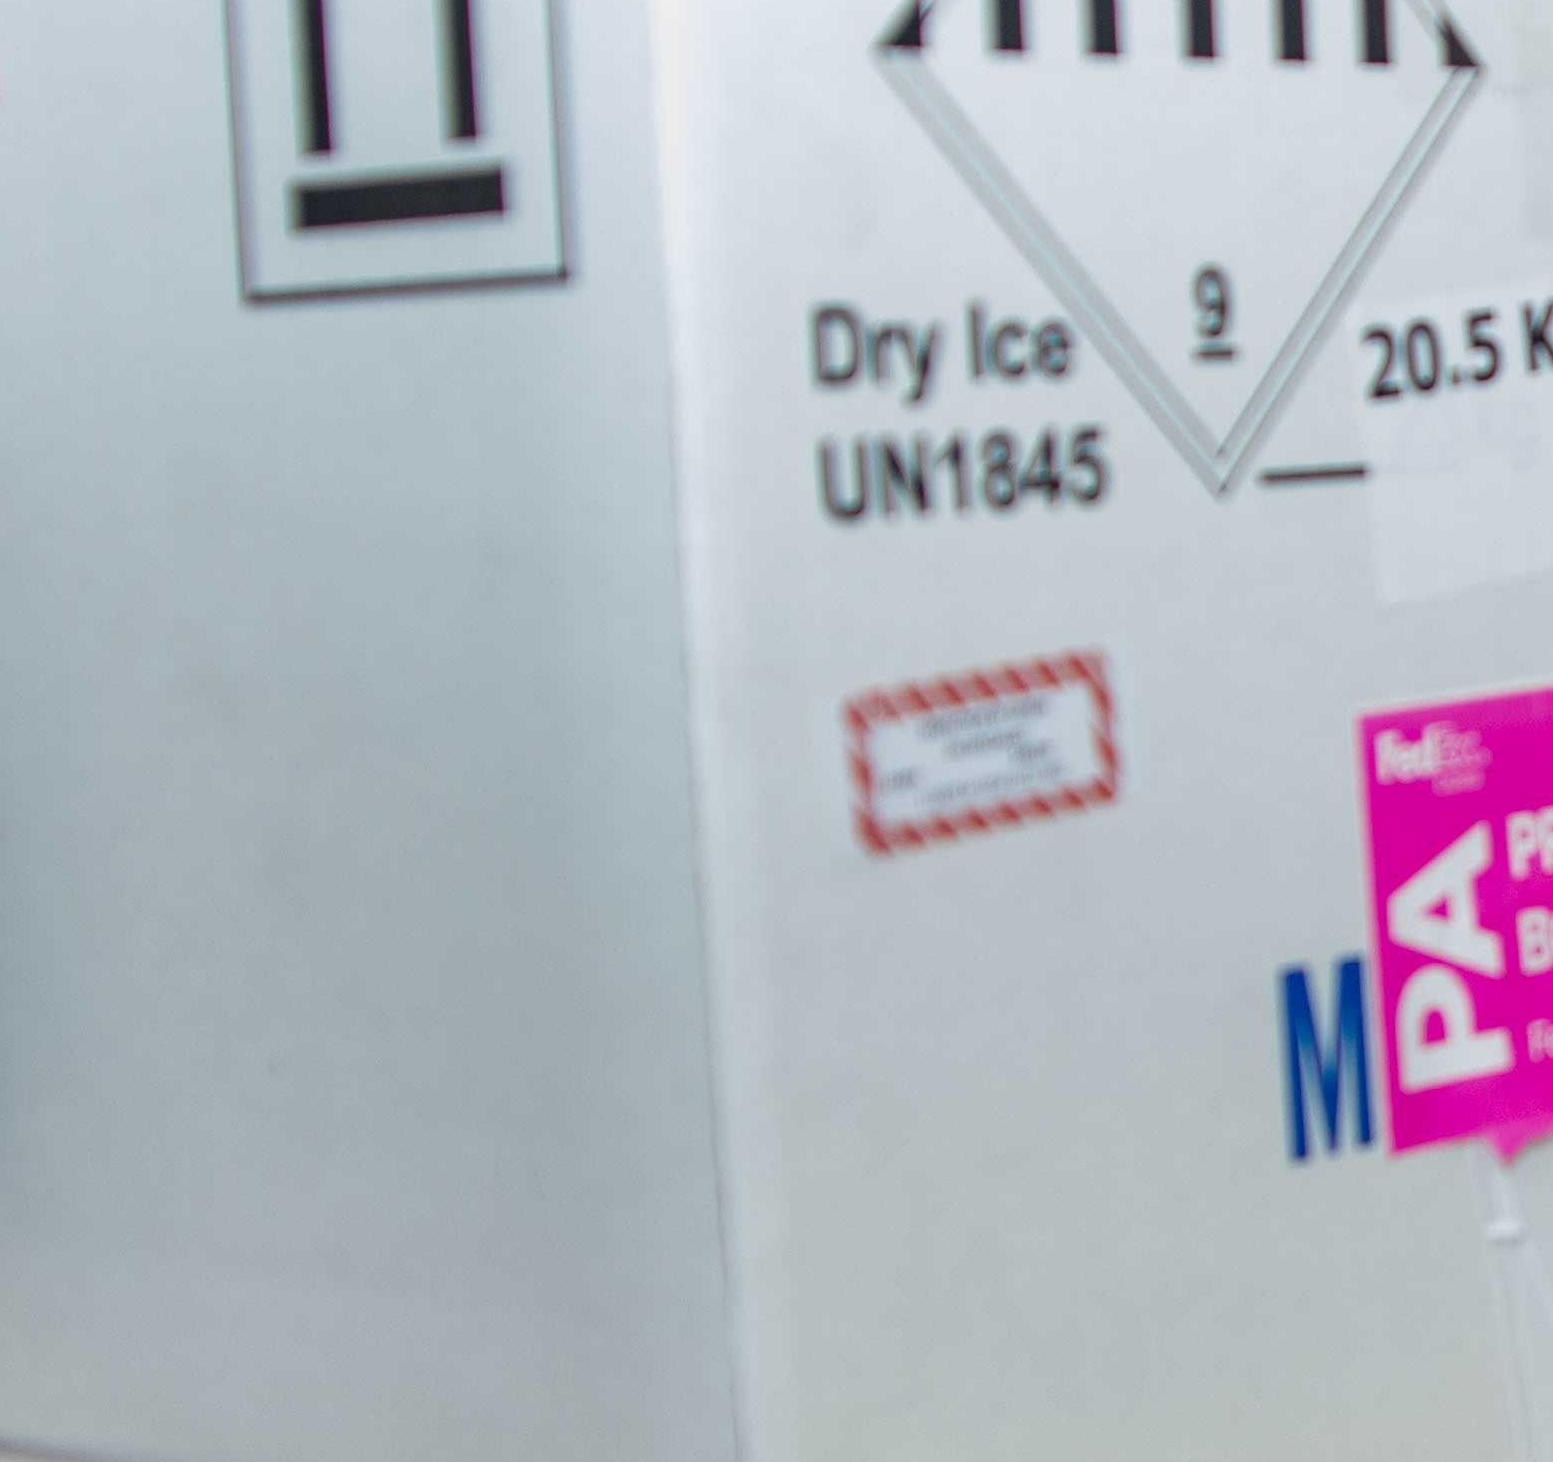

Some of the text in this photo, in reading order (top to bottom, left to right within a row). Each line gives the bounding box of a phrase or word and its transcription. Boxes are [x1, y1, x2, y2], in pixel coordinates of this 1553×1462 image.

[1192, 263, 1233, 337] 9
[812, 298, 1072, 405] Dry Ice
[1363, 308, 1500, 401] 20.5
[818, 427, 1108, 524] UN1845
[1387, 819, 1515, 1094] PA
